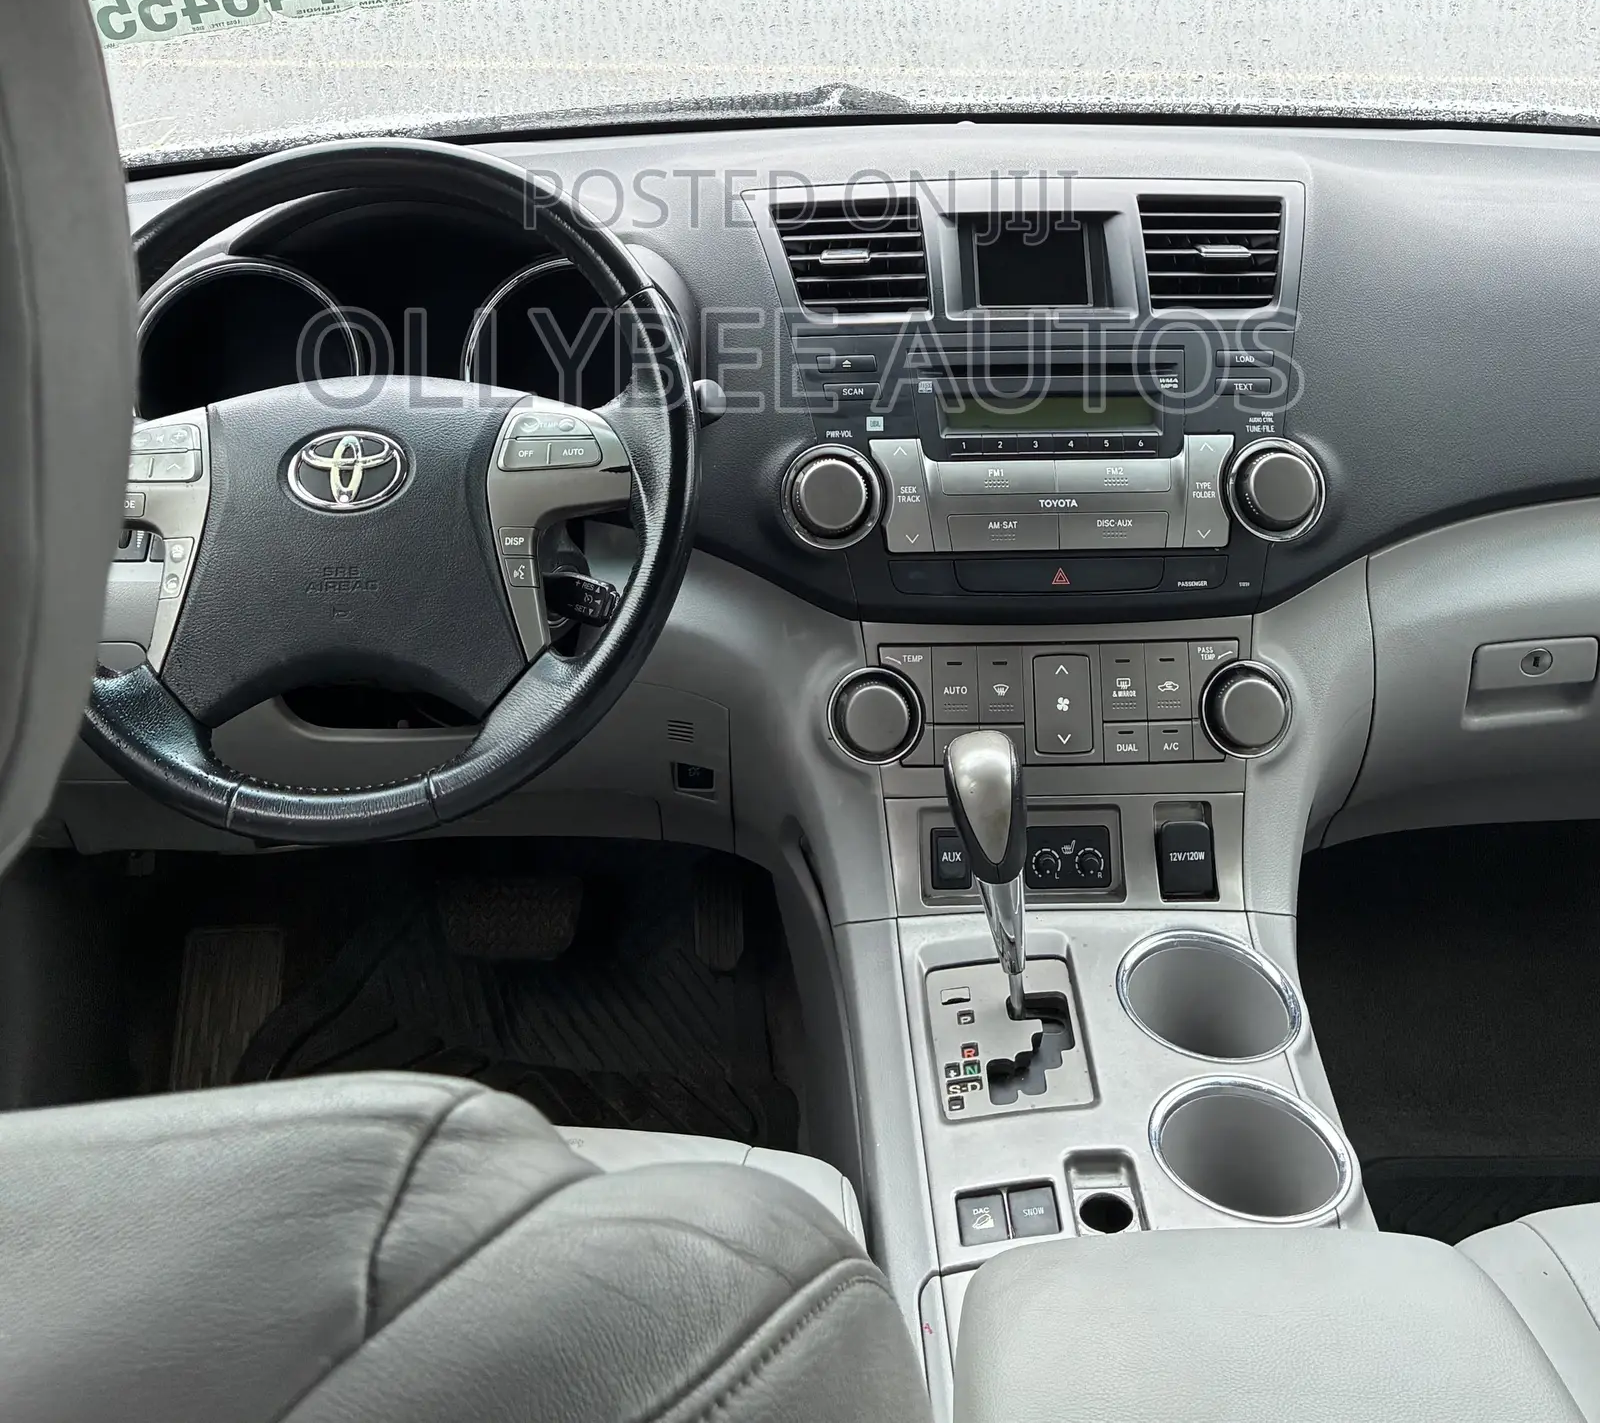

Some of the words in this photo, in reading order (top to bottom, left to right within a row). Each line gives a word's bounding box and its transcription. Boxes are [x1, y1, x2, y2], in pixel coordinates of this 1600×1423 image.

[1235, 355, 1255, 363] LOAD
[1234, 383, 1253, 391] TEXT
[842, 388, 864, 396] SCAN
[962, 441, 966, 449] 1
[997, 440, 1003, 448] 2
[1033, 440, 1039, 448] 3
[1068, 440, 1074, 448] 4
[1104, 439, 1110, 447] 5
[1138, 439, 1144, 447] 6
[562, 448, 584, 456] AUTO
[988, 469, 1004, 477] FM1
[1106, 468, 1124, 476] FM2
[900, 486, 917, 494] SEEK
[1195, 482, 1211, 490] TYPE
[1192, 490, 1216, 499] FOLDER
[897, 495, 921, 503] TRACK
[1039, 499, 1078, 508] TOYOTA
[504, 537, 525, 546] DISP
[581, 581, 595, 591] RES
[1197, 646, 1214, 654] PASS
[902, 654, 924, 663] TEMP
[1200, 653, 1216, 661] TEMP
[943, 686, 968, 695] AUTO
[1116, 743, 1139, 752] DUAL
[1163, 742, 1179, 751] A/C
[941, 851, 962, 863] AUX
[1169, 851, 1205, 862] 12V/120W
[960, 1016, 971, 1024] P
[963, 1048, 976, 1058] R
[965, 1065, 978, 1075] N
[972, 1207, 990, 1215] DAC
[1022, 1207, 1045, 1217] SNOW
